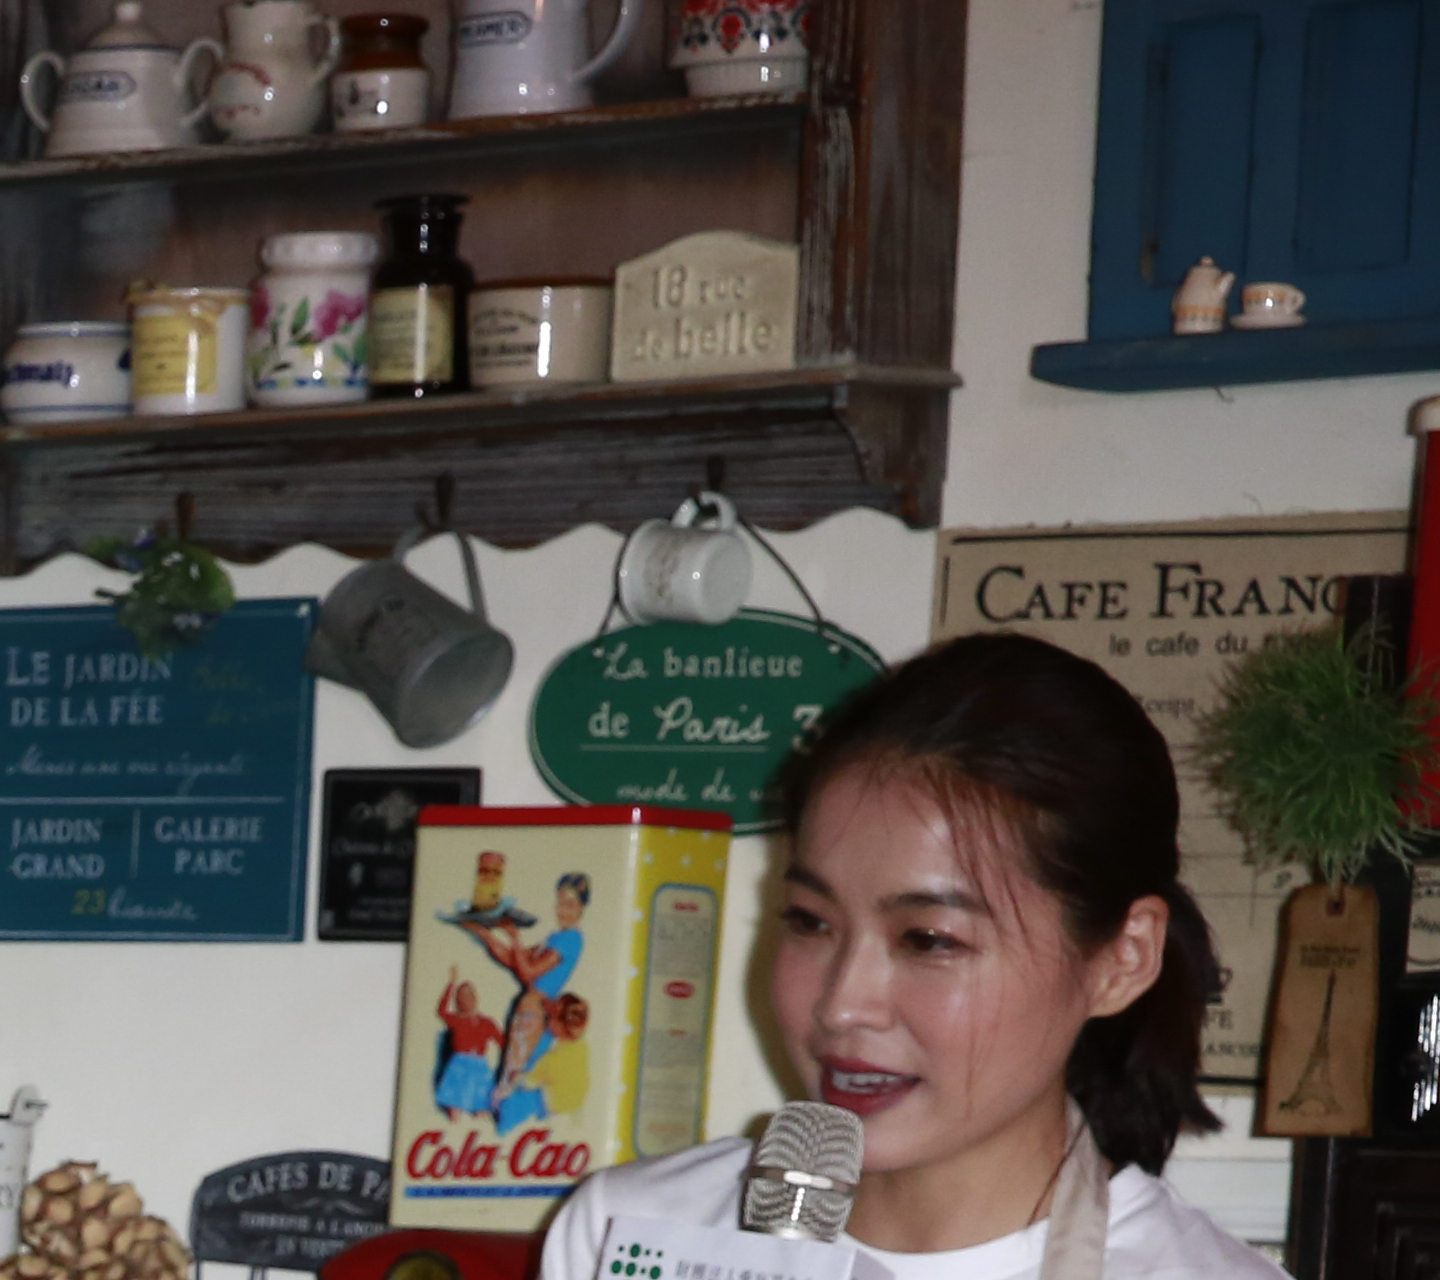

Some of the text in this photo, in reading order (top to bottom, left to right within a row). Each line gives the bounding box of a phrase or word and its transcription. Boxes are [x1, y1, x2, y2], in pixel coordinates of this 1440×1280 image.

[652, 264, 688, 309] 18
[674, 310, 772, 360] belle
[975, 563, 1129, 623] CAFE
[602, 642, 804, 681] La banlieue
[1107, 630, 1249, 658] le cafe du
[5, 646, 52, 688] LE
[63, 652, 174, 692] JARDIN
[9, 695, 50, 728] DE
[58, 695, 100, 728] LA
[587, 700, 631, 739] de
[653, 695, 771, 744] Paris
[11, 815, 266, 850] JARDIN GALERIE
[11, 848, 247, 881] GRAND PARC
[226, 1161, 310, 1204] CAFES
[317, 1160, 355, 1193] DE
